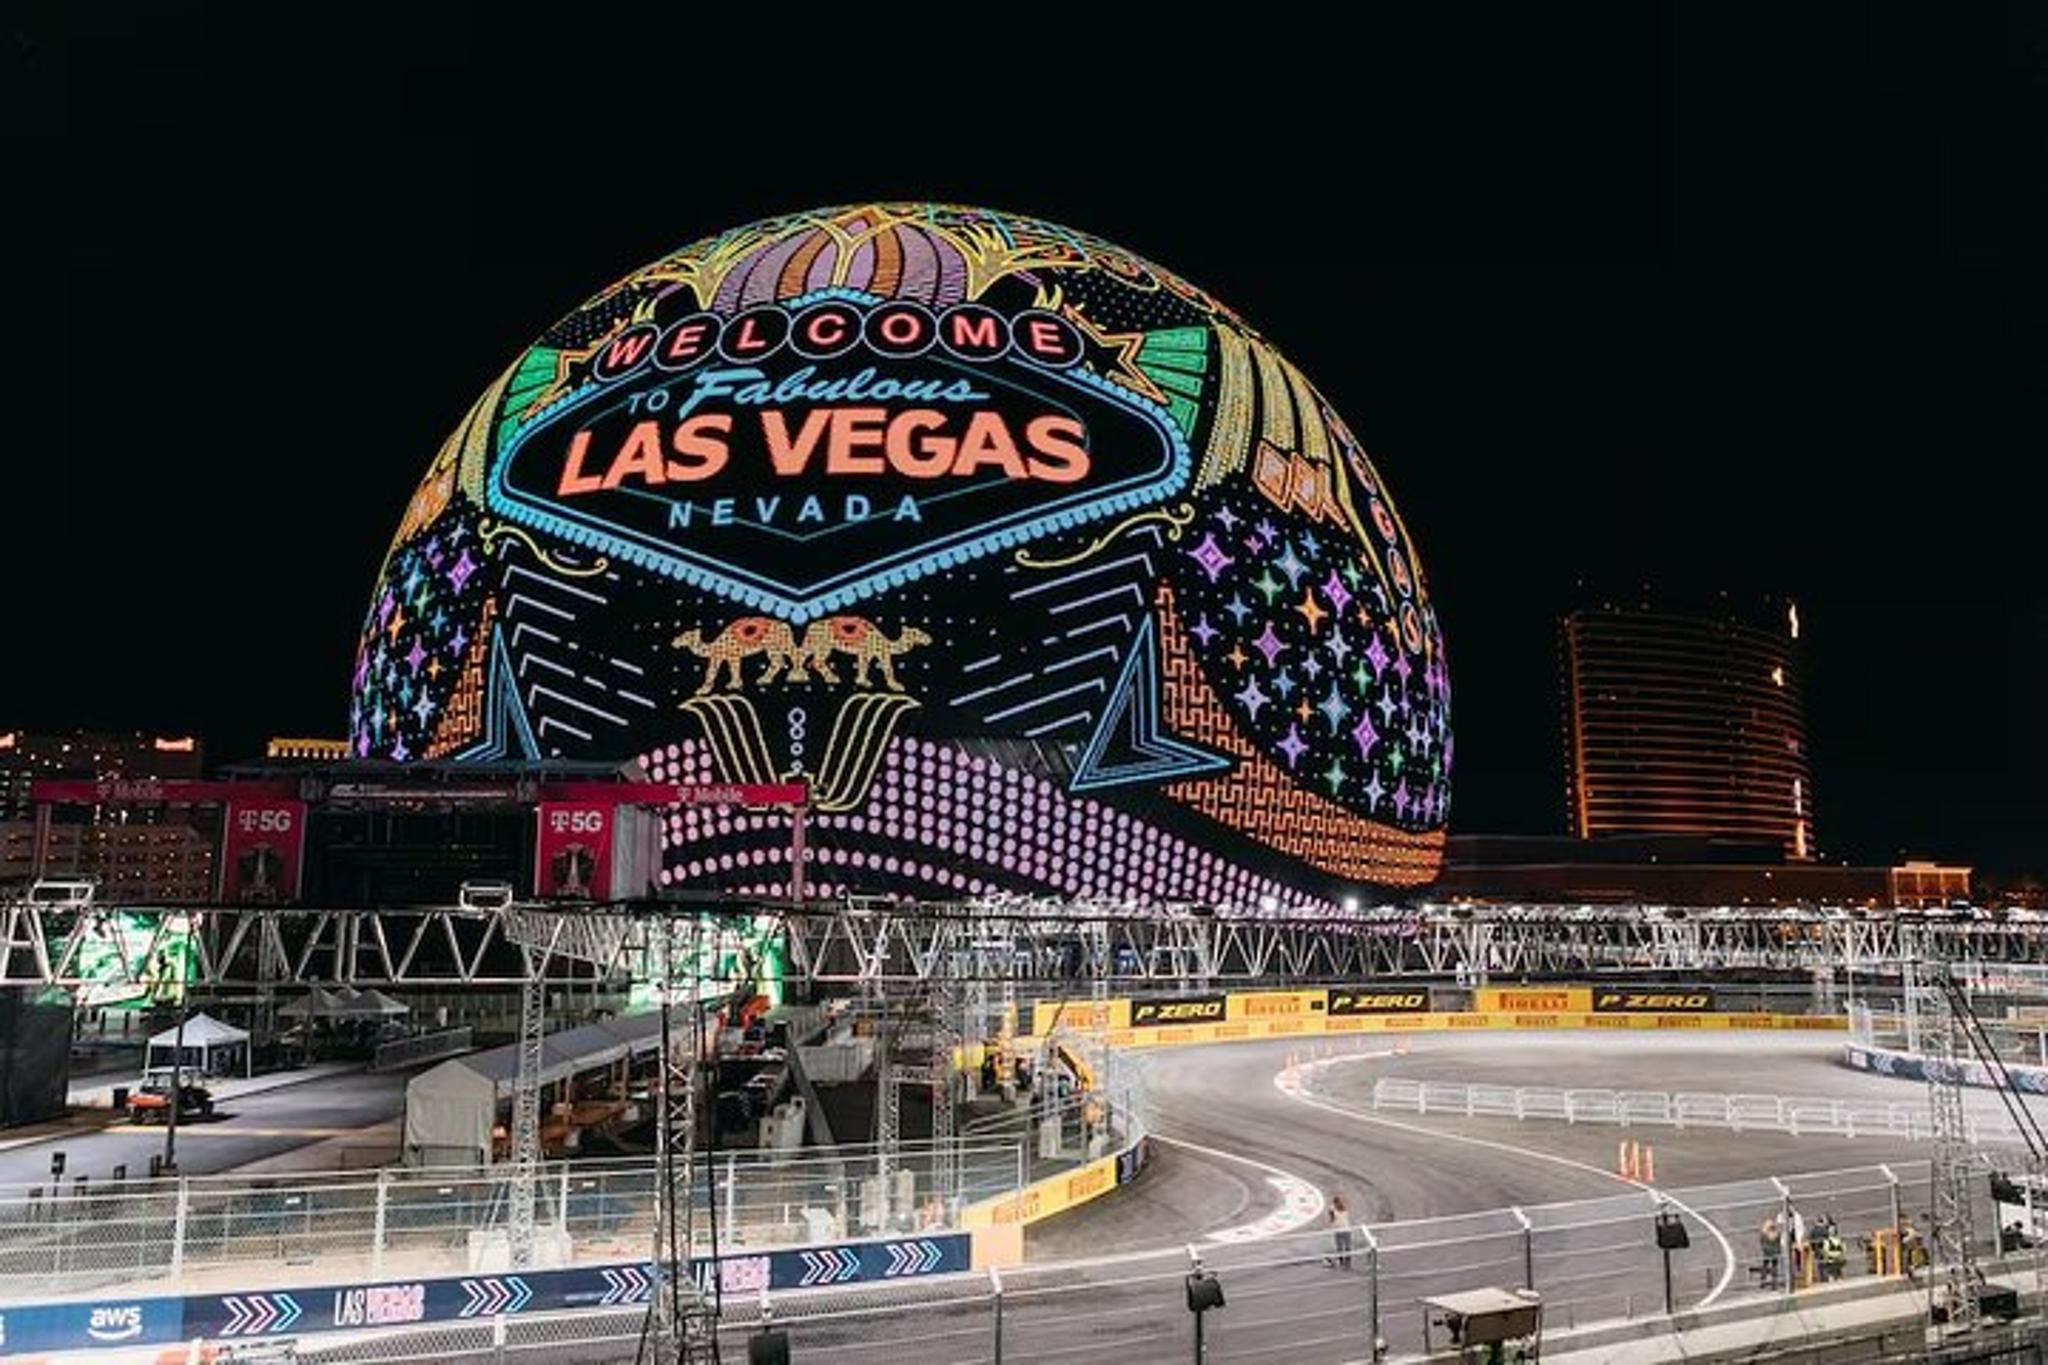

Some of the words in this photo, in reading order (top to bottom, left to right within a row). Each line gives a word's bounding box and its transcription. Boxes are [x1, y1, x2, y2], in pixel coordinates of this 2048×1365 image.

[607, 313, 1065, 368] WELCOME
[627, 388, 668, 415] TO
[677, 366, 991, 421] Fabulous
[556, 414, 733, 496] LAS
[760, 408, 1091, 483] VEGAS
[667, 495, 923, 529] NEVADA
[260, 809, 292, 832] 5G
[571, 810, 603, 833] 5G
[1157, 1002, 1222, 1019] ZERO
[1354, 994, 1424, 1008] ZERO
[1625, 994, 1708, 1008] ZERO
[90, 1306, 142, 1328] aws
[334, 1289, 365, 1326] LAS
